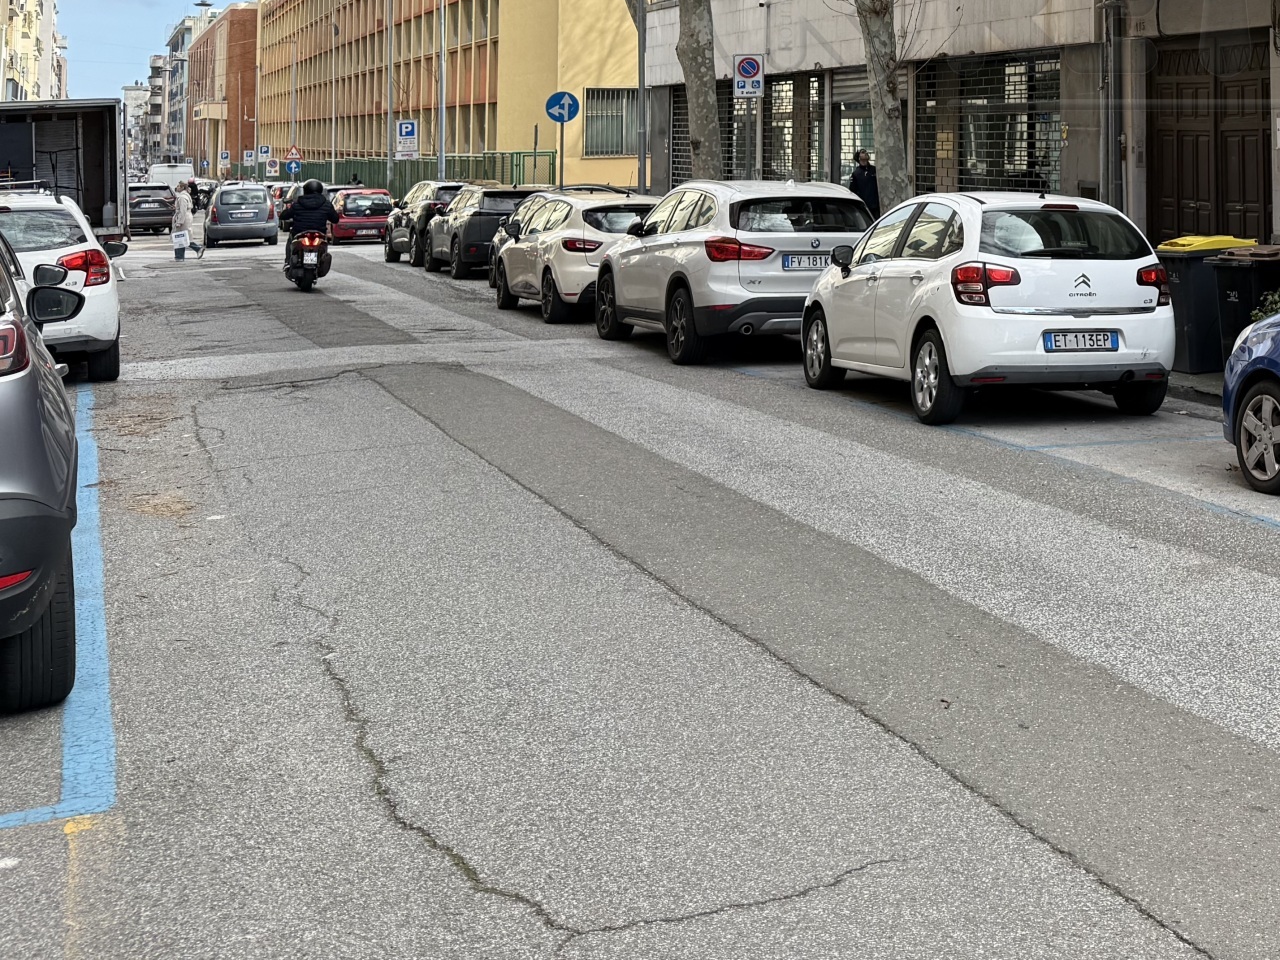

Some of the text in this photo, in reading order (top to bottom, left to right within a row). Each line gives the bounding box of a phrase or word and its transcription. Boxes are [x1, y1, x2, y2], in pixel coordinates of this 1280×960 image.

[402, 124, 412, 136] P
[790, 256, 802, 267] FV
[1054, 334, 1068, 347] ET
[1074, 334, 1109, 347] 113EP
